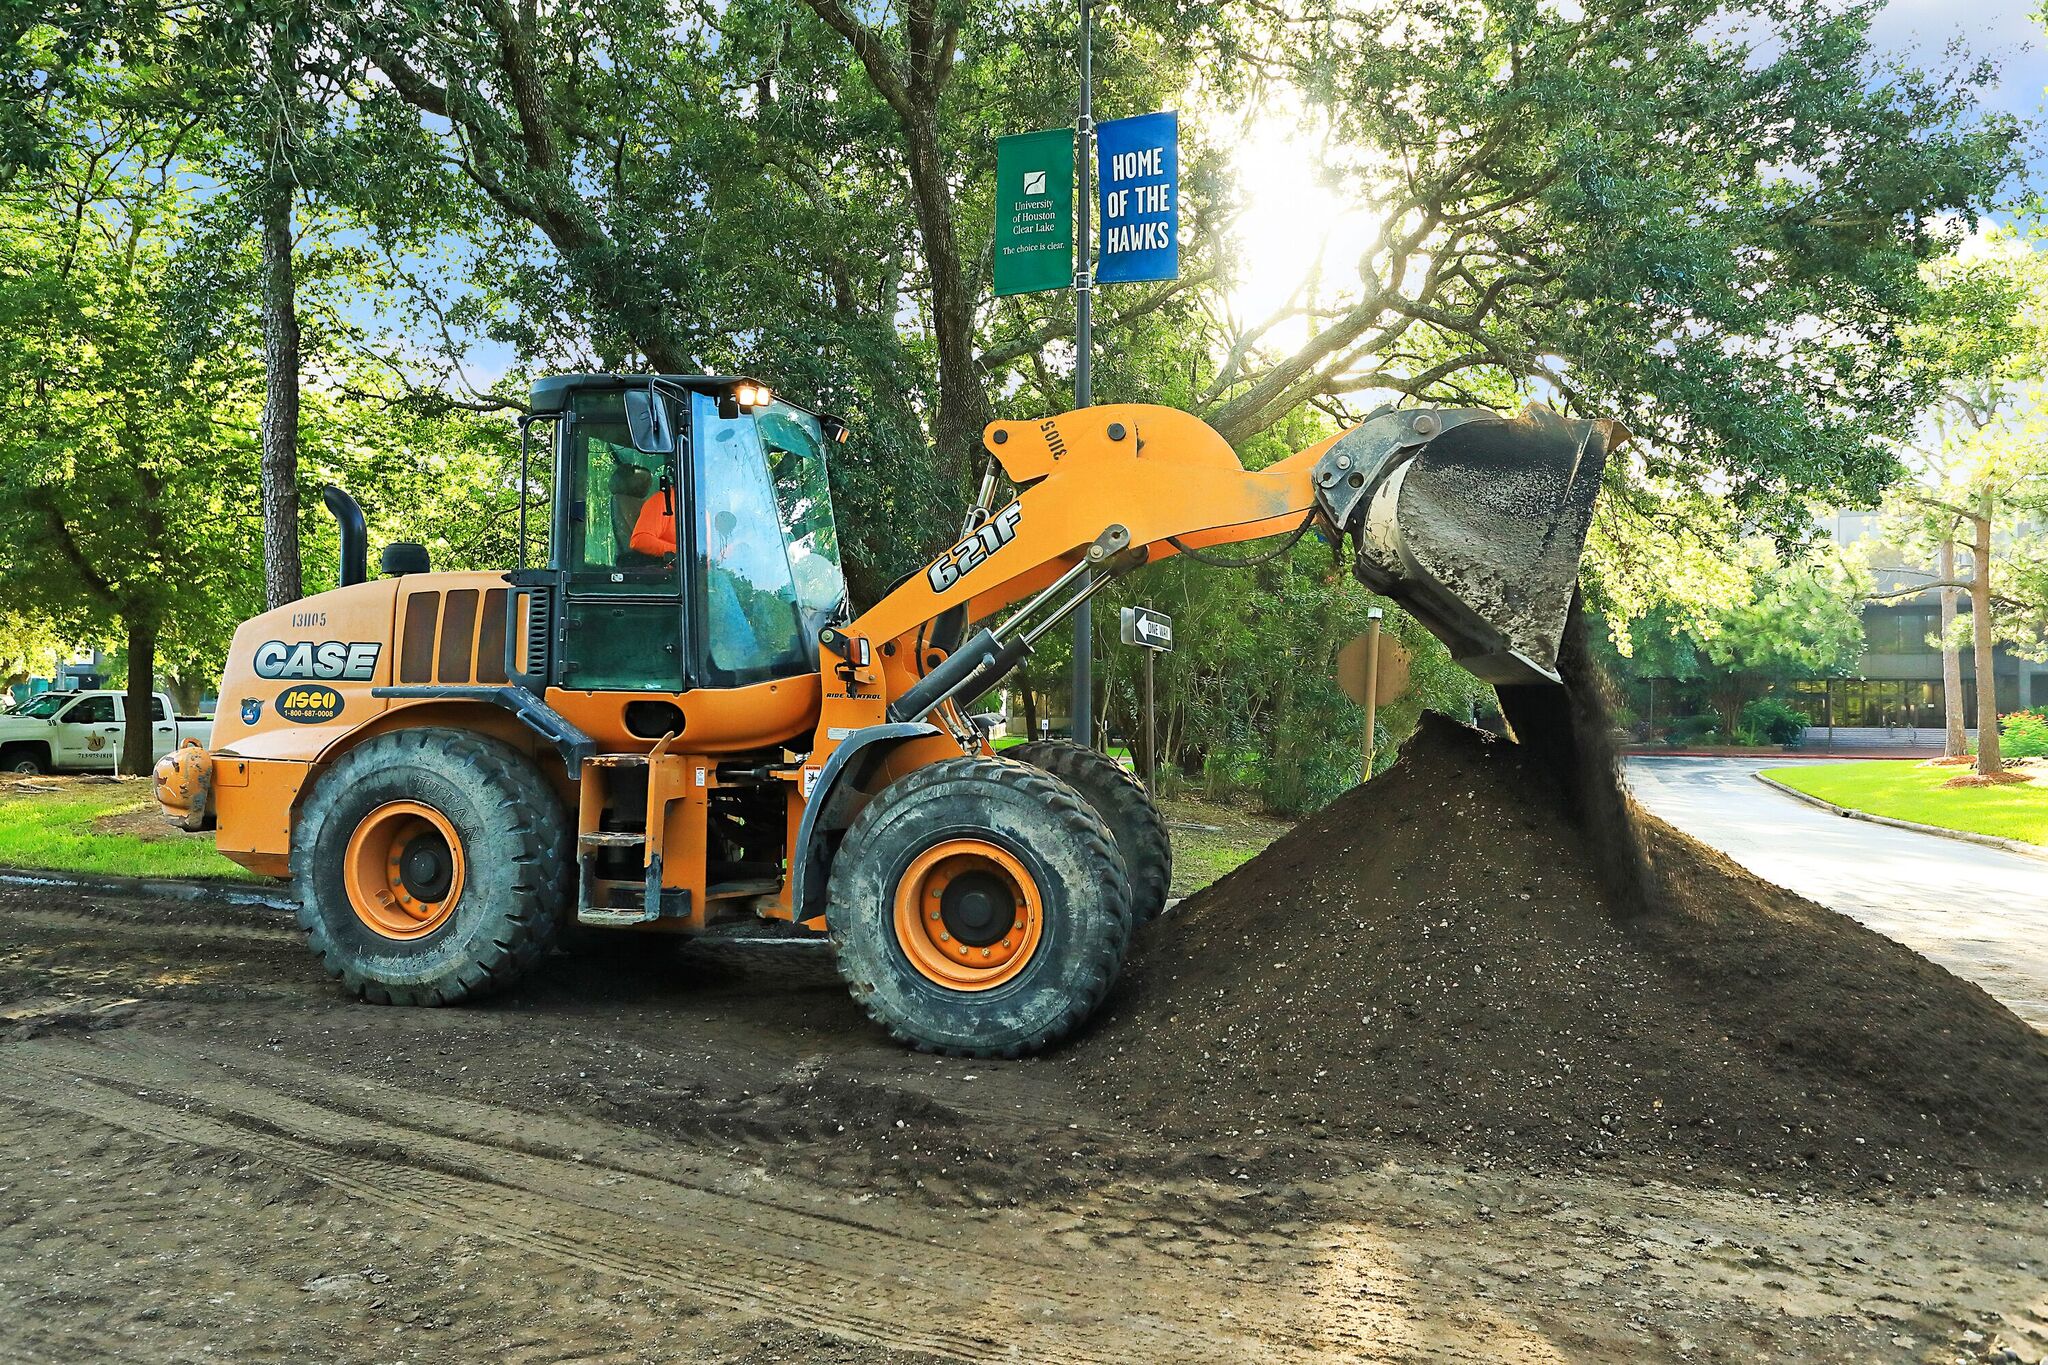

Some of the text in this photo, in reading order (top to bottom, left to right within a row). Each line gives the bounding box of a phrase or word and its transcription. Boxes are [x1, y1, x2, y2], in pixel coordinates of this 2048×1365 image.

[1112, 147, 1164, 182] HOME
[1015, 200, 1054, 211] University
[1107, 183, 1170, 218] OF THE
[1012, 212, 1056, 223] of Houston
[1012, 222, 1055, 235] Clear Lake
[1002, 246, 1015, 255] The
[1016, 244, 1039, 253] choice
[1046, 241, 1065, 250] clear.
[1107, 221, 1169, 254] HAWKS
[926, 500, 1023, 594] 621F
[1147, 622, 1169, 638] ONE WAY
[253, 639, 382, 682] CASE
[283, 691, 336, 709] ASCO
[414, 774, 481, 844] TITAN
